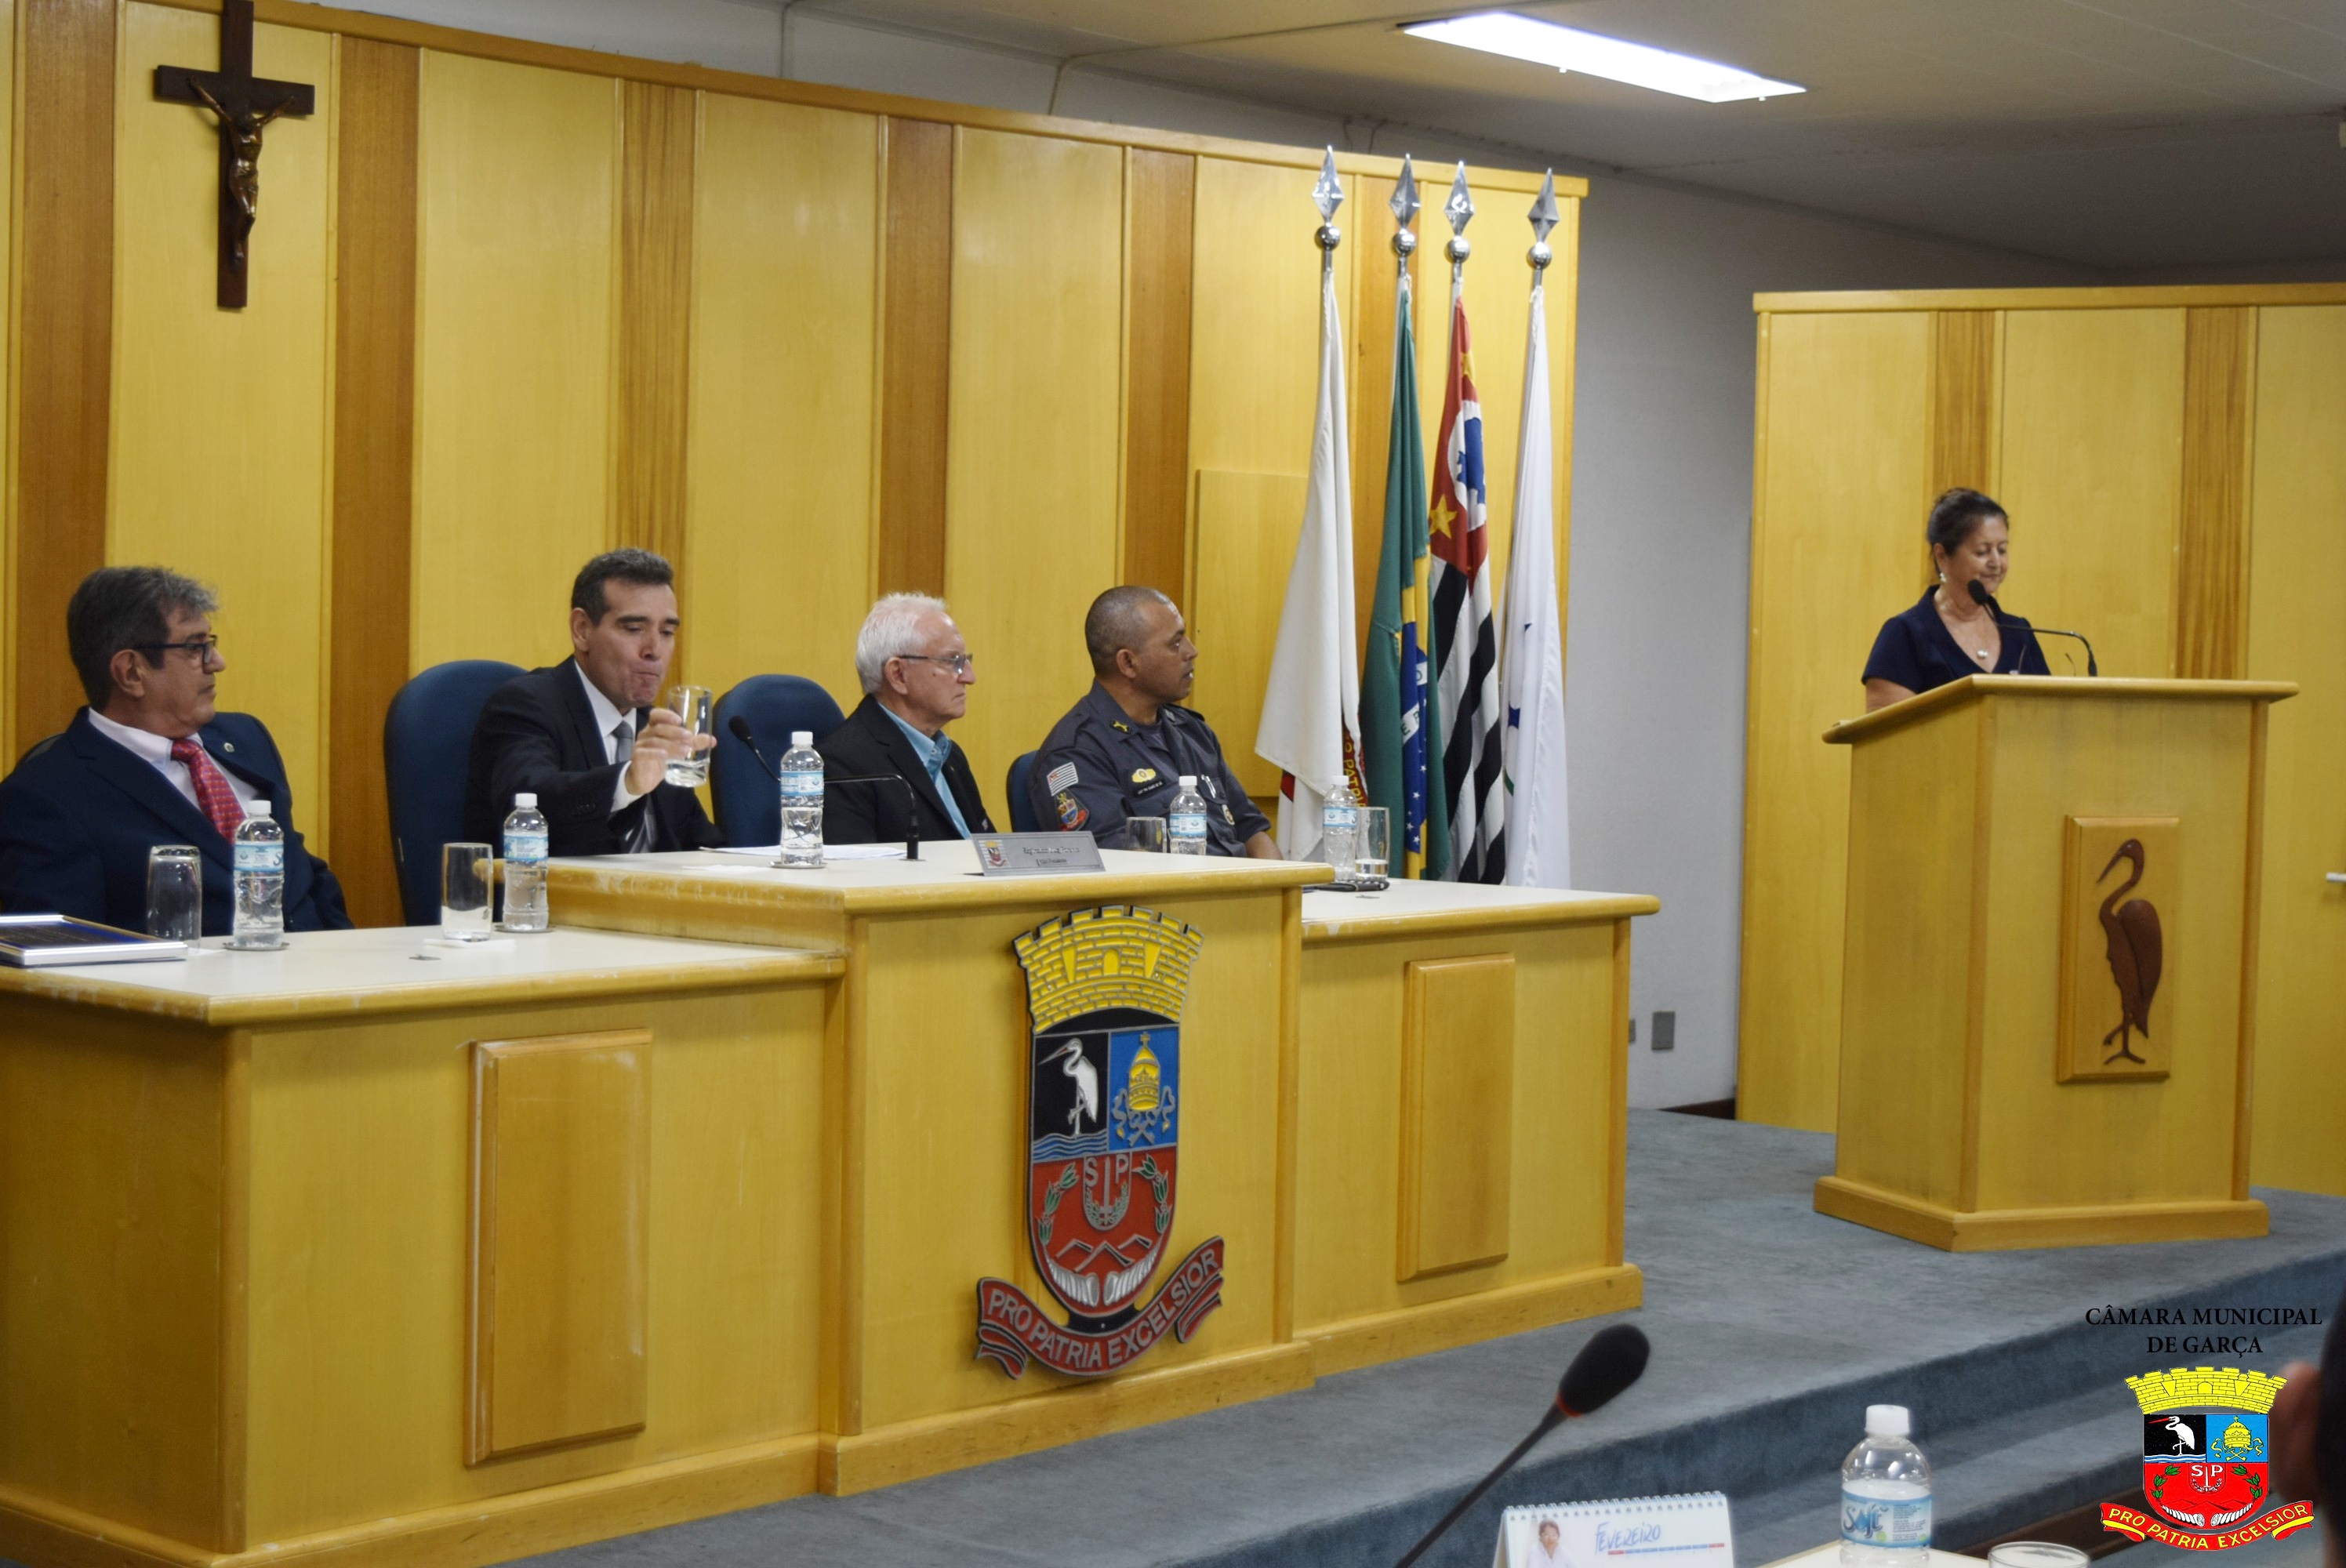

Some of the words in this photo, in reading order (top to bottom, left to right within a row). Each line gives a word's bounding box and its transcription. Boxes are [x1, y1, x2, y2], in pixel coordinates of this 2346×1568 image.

[988, 1288, 1033, 1333] PRO
[1028, 1319, 1102, 1369] PATRIA
[1107, 1248, 1219, 1366] EXCELSIOR
